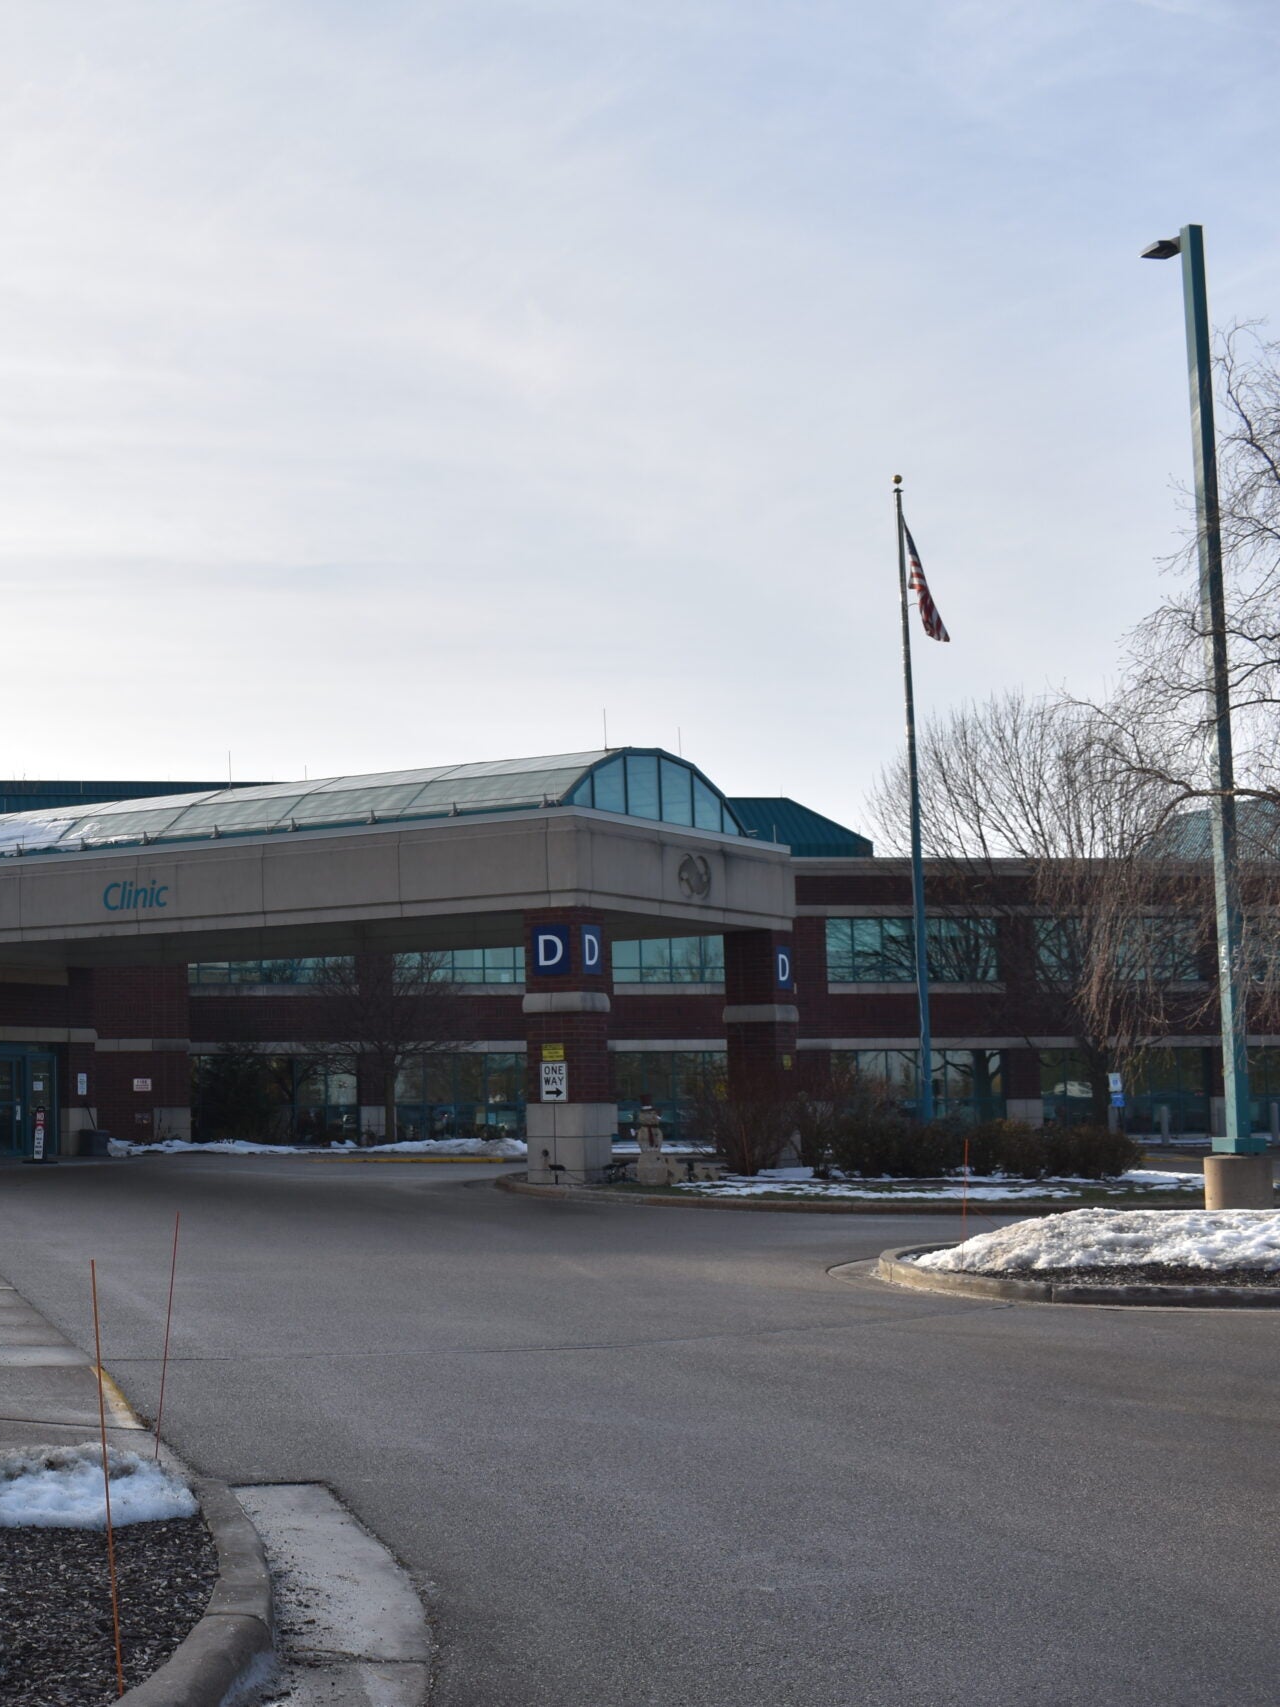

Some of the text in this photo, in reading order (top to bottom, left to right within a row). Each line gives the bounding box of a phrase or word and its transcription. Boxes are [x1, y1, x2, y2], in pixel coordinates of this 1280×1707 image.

[102, 879, 169, 911] Clinic
[538, 934, 563, 966] D
[584, 934, 599, 966] D
[778, 953, 790, 981] D
[543, 1065, 564, 1075] ONE
[543, 1076, 564, 1086] WAY
